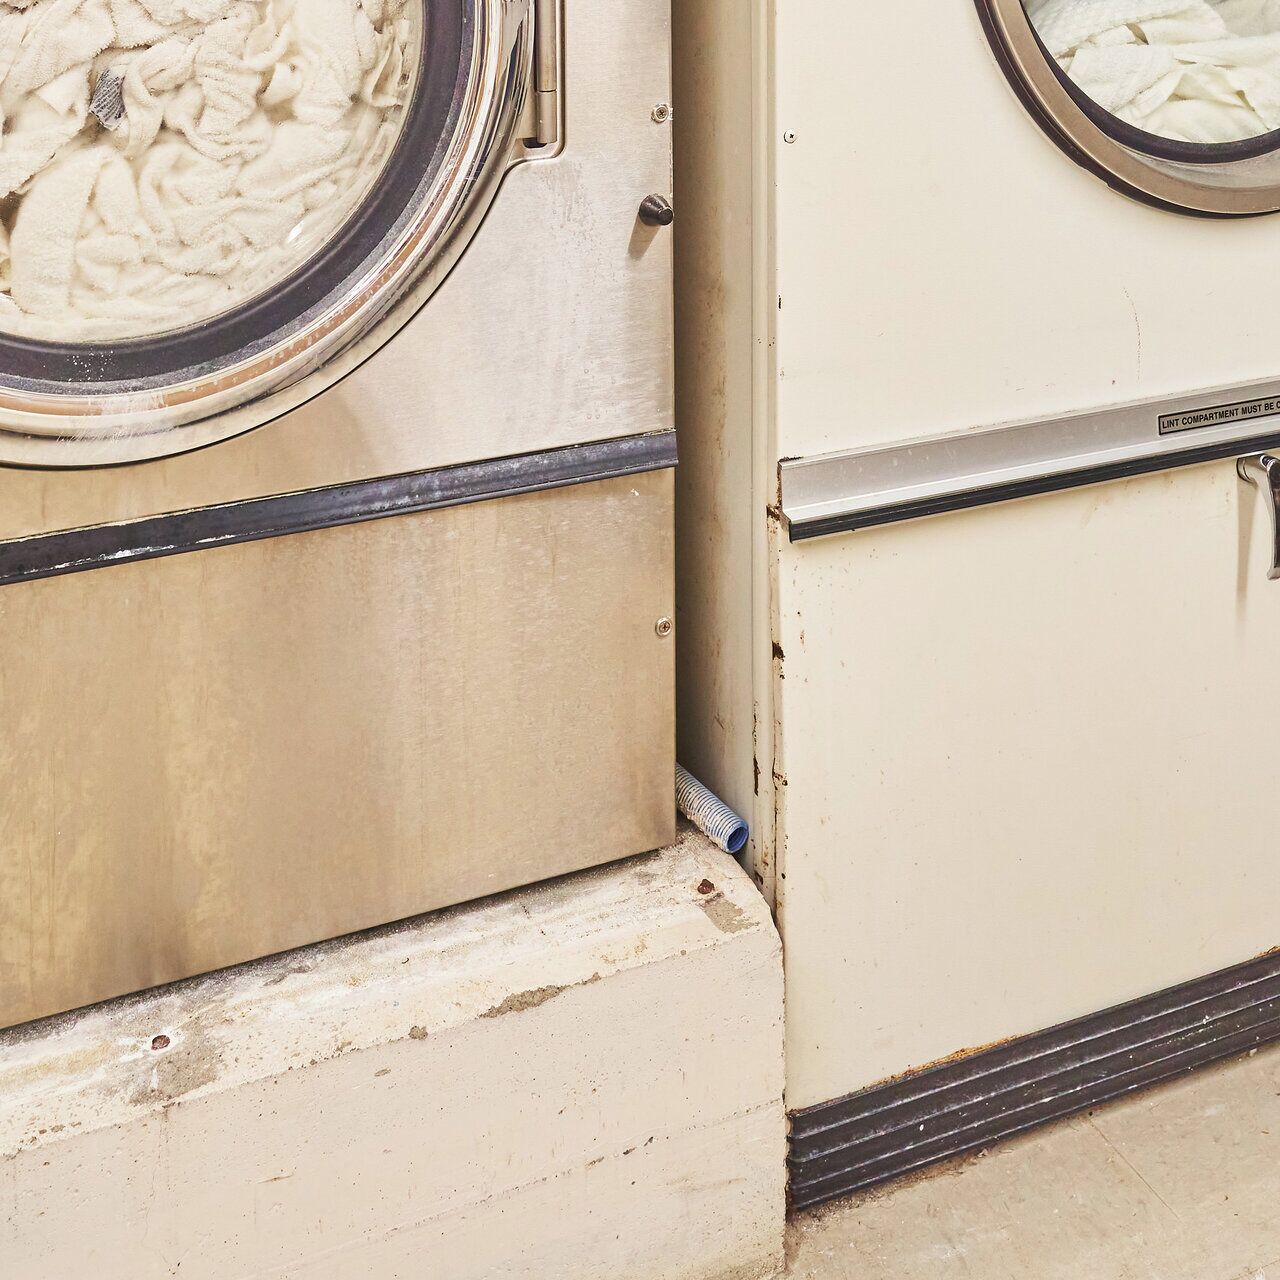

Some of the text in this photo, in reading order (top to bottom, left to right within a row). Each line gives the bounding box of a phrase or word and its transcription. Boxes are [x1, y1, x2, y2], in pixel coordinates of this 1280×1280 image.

[1162, 418, 1180, 429] LINT
[1182, 408, 1239, 426] COMPARTMENT
[1241, 404, 1262, 415] MUST
[1264, 403, 1274, 411] BE
